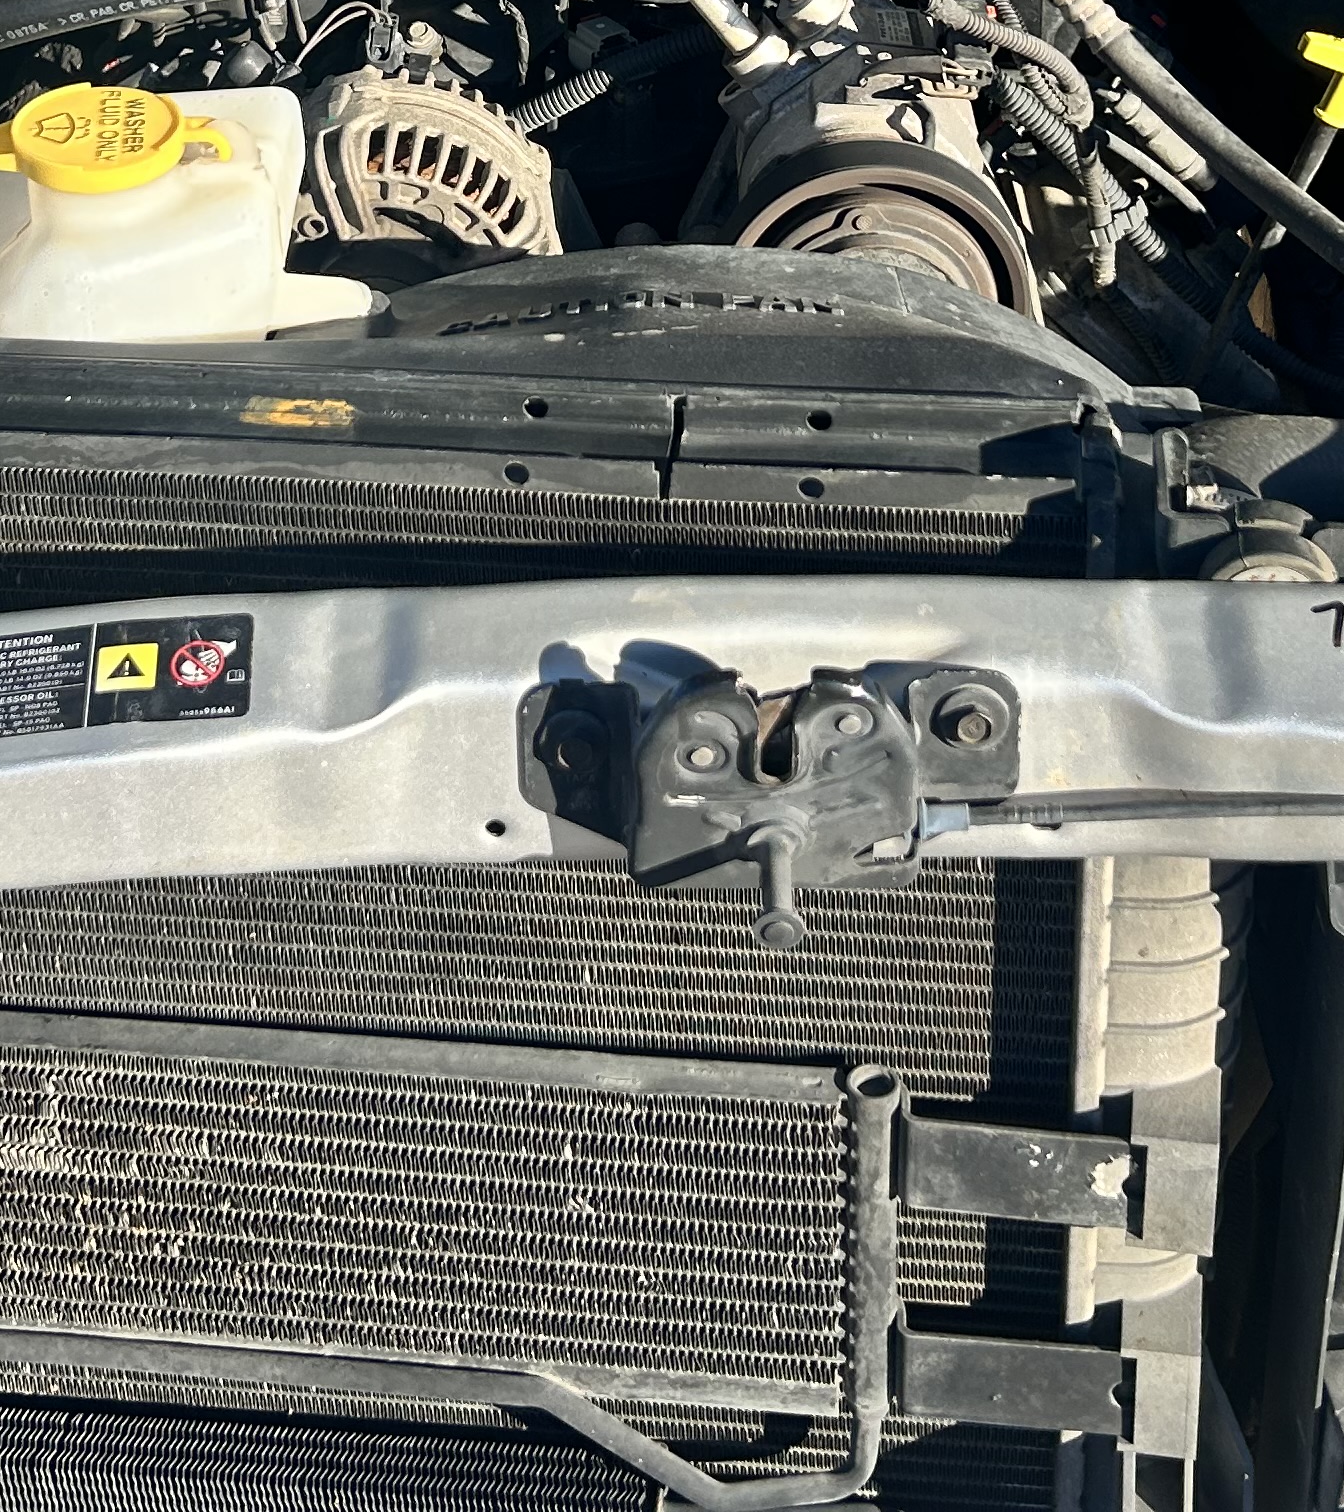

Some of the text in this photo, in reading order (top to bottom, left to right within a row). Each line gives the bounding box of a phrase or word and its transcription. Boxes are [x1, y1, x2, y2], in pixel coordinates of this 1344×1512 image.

[94, 90, 122, 162] FLUID ONLY
[121, 97, 146, 154] WASHER
[437, 289, 846, 337] CAUTION FAN
[7, 640, 82, 660] REFRIGERANT
